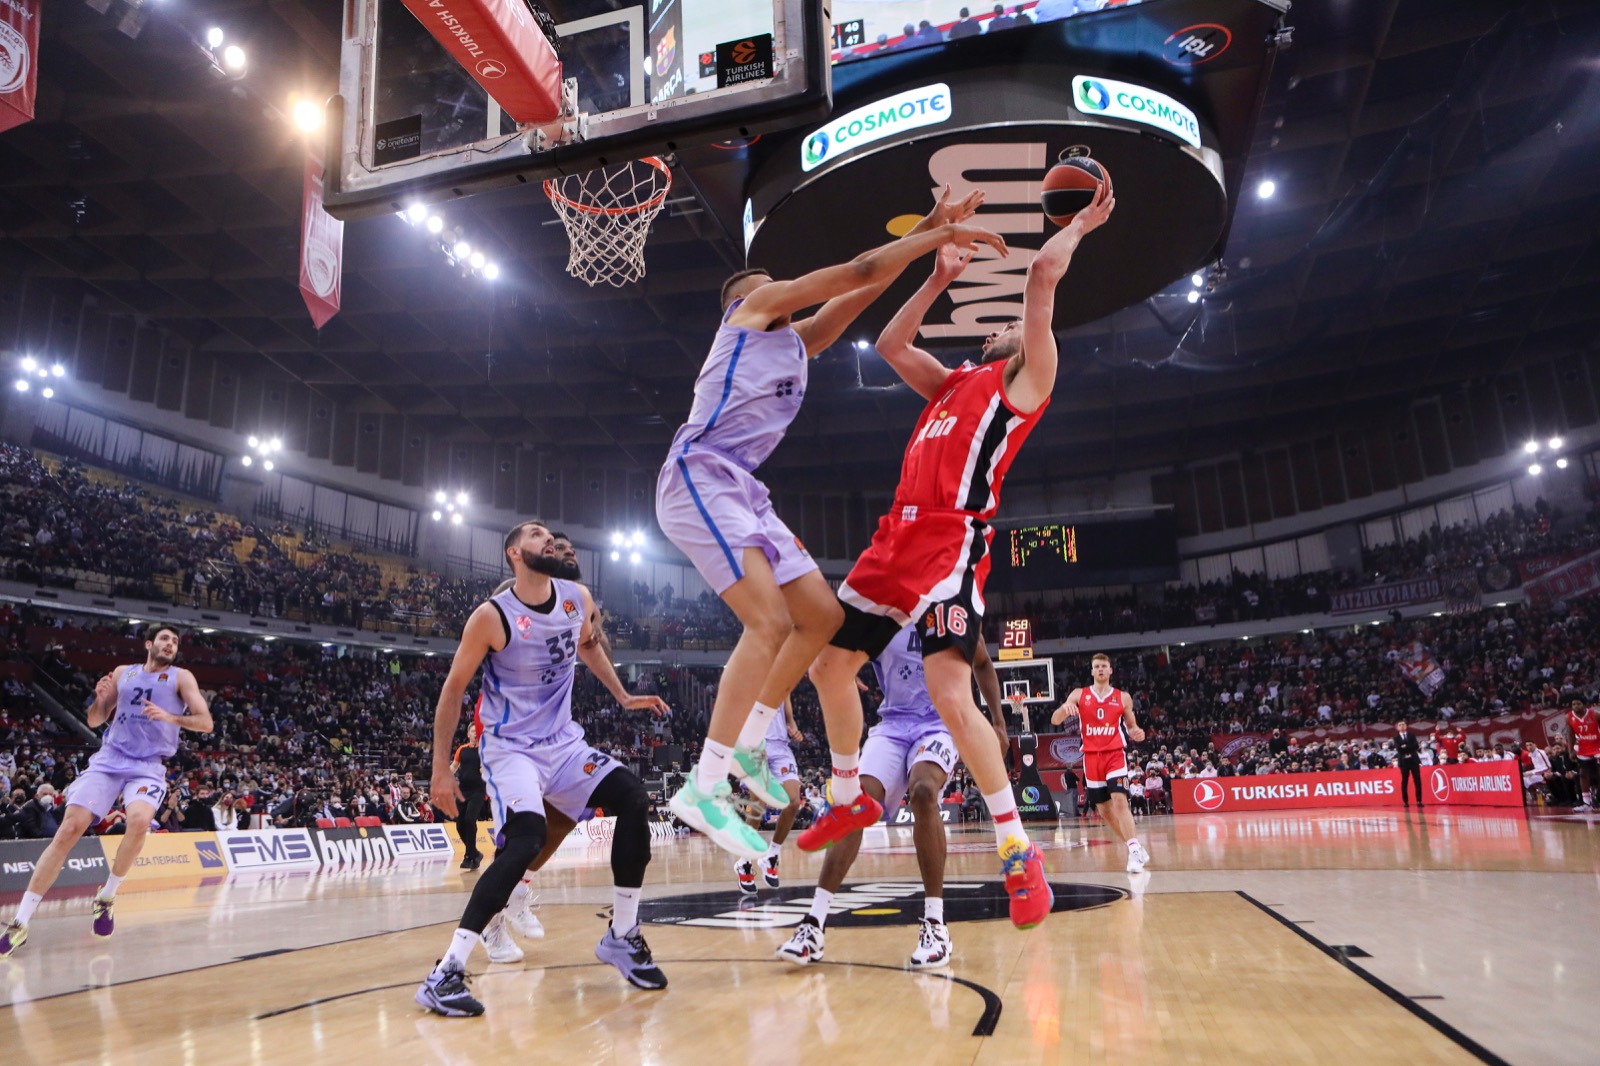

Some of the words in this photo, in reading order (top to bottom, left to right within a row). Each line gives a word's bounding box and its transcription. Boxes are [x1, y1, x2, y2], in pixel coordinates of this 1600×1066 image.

[436, 10, 484, 58] TURKISH
[844, 21, 860, 33] 40
[845, 33, 860, 45] 47
[725, 61, 765, 76] TURKISH
[725, 68, 766, 83] AIRLINES
[834, 94, 945, 143] COSMOTE
[1117, 92, 1198, 138] COSMOTE
[886, 143, 1047, 340] bwin
[934, 603, 968, 638] 16
[1006, 619, 1028, 630] 4:58
[545, 630, 576, 665] 33
[907, 631, 923, 653] 4
[1003, 631, 1026, 647] 20
[130, 687, 153, 706] 21
[1097, 708, 1105, 719] 0
[1086, 722, 1116, 736] bwin
[1578, 725, 1589, 733] 77
[1231, 784, 1309, 800] TURKISH
[1313, 780, 1395, 797] AIRLINES
[1451, 777, 1478, 792] TURKISH
[1479, 775, 1512, 792] AIRLINES
[146, 784, 165, 804] 21
[895, 808, 951, 823] bn
[227, 833, 312, 865] FMS
[316, 826, 391, 864] bwin
[390, 828, 448, 851] FMS
[68, 856, 104, 871] QUIT
